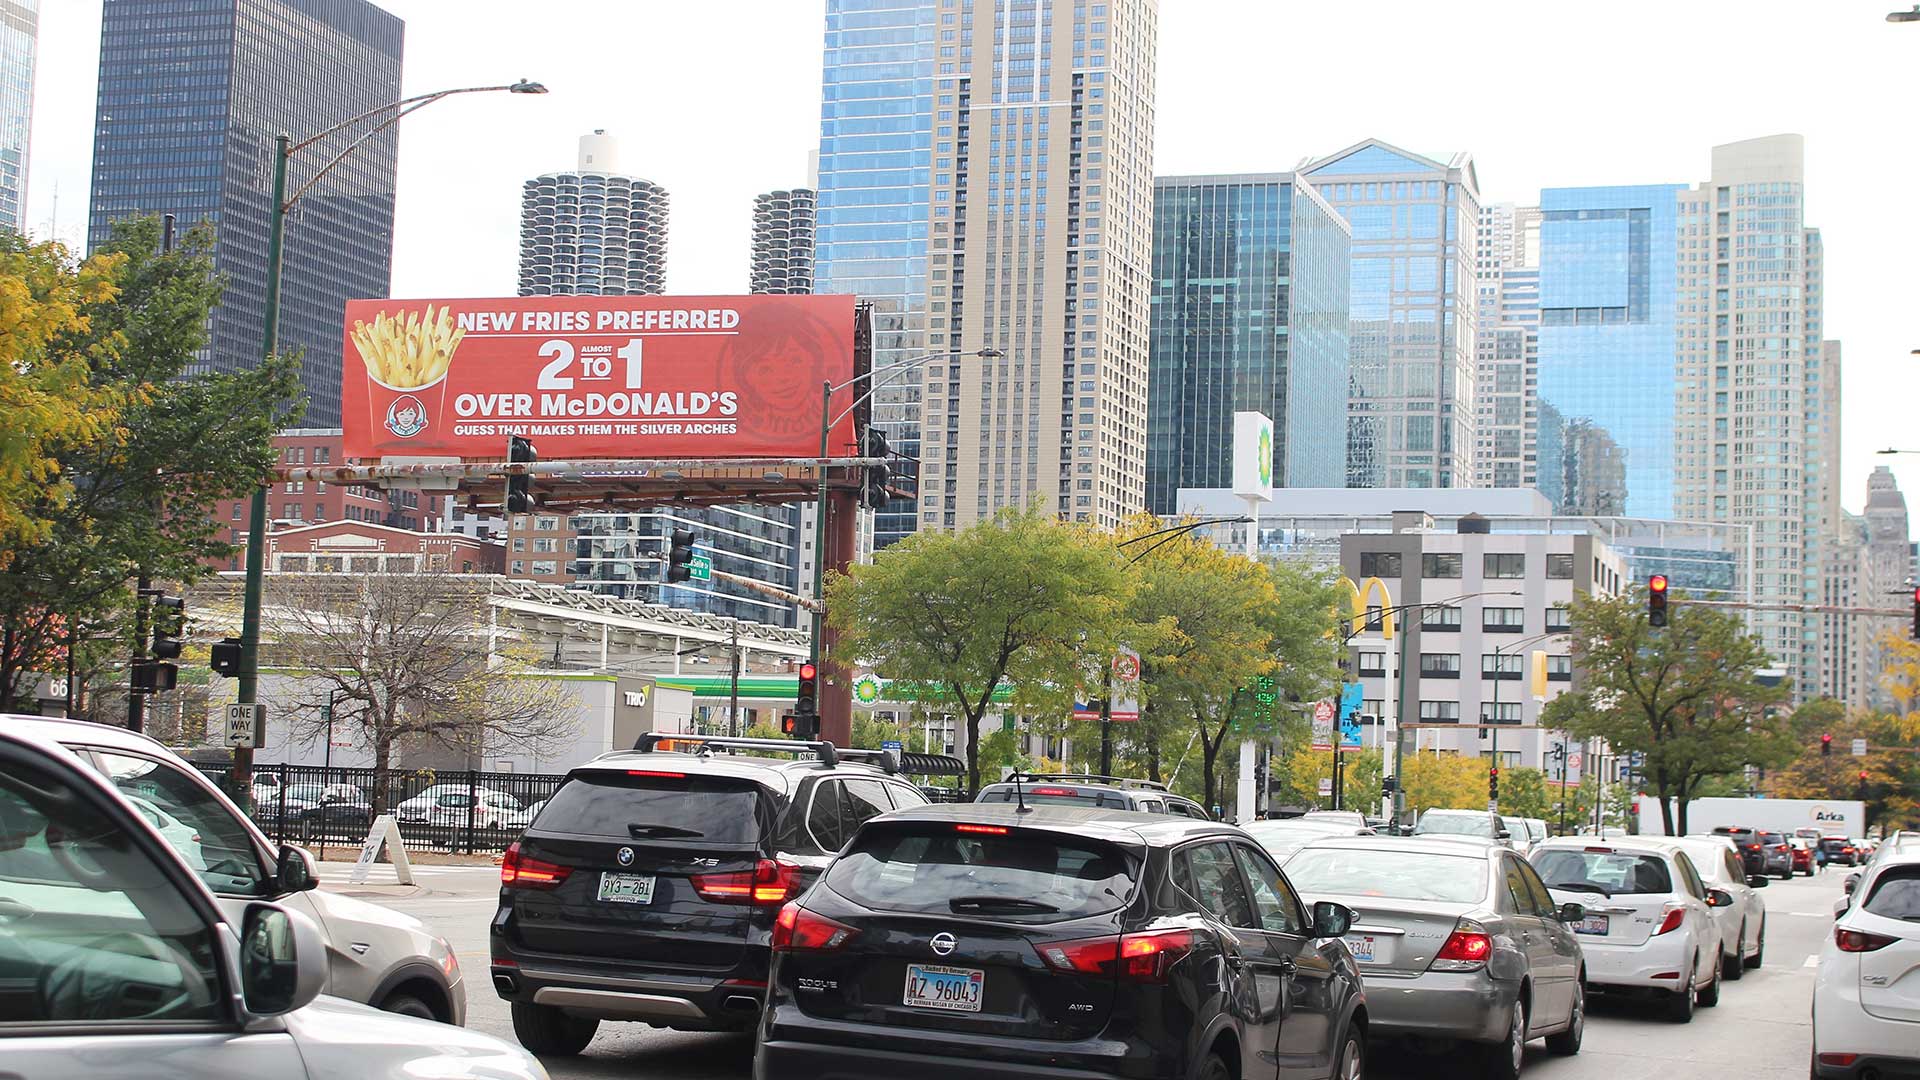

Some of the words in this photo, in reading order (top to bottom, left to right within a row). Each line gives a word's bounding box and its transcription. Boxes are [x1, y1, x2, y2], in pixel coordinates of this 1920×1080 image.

[458, 312, 516, 331] NEW
[522, 311, 590, 331] FRIES
[597, 309, 740, 330] PREFERRED
[581, 345, 613, 353] ALMOST
[537, 339, 575, 390] 2
[580, 356, 612, 377] TO
[617, 338, 643, 389] 1
[454, 393, 533, 417] OVER
[540, 391, 738, 416] McDONALD'S
[454, 424, 495, 436] GUESS
[497, 424, 529, 435] THAT
[530, 424, 575, 436] MAKES
[578, 424, 612, 435] THEM
[615, 424, 638, 435] THE
[640, 424, 682, 435] SILVER
[684, 423, 737, 434] ARCHES
[624, 691, 646, 707] TRIO
[231, 706, 251, 718] ONE
[231, 720, 251, 730] WAY
[800, 752, 815, 761] ONE
[1816, 811, 1844, 821] Arka
[690, 857, 720, 867] X5
[909, 977, 928, 999] AZ
[935, 979, 979, 1003] 96043
[1068, 1003, 1094, 1011] AWD
